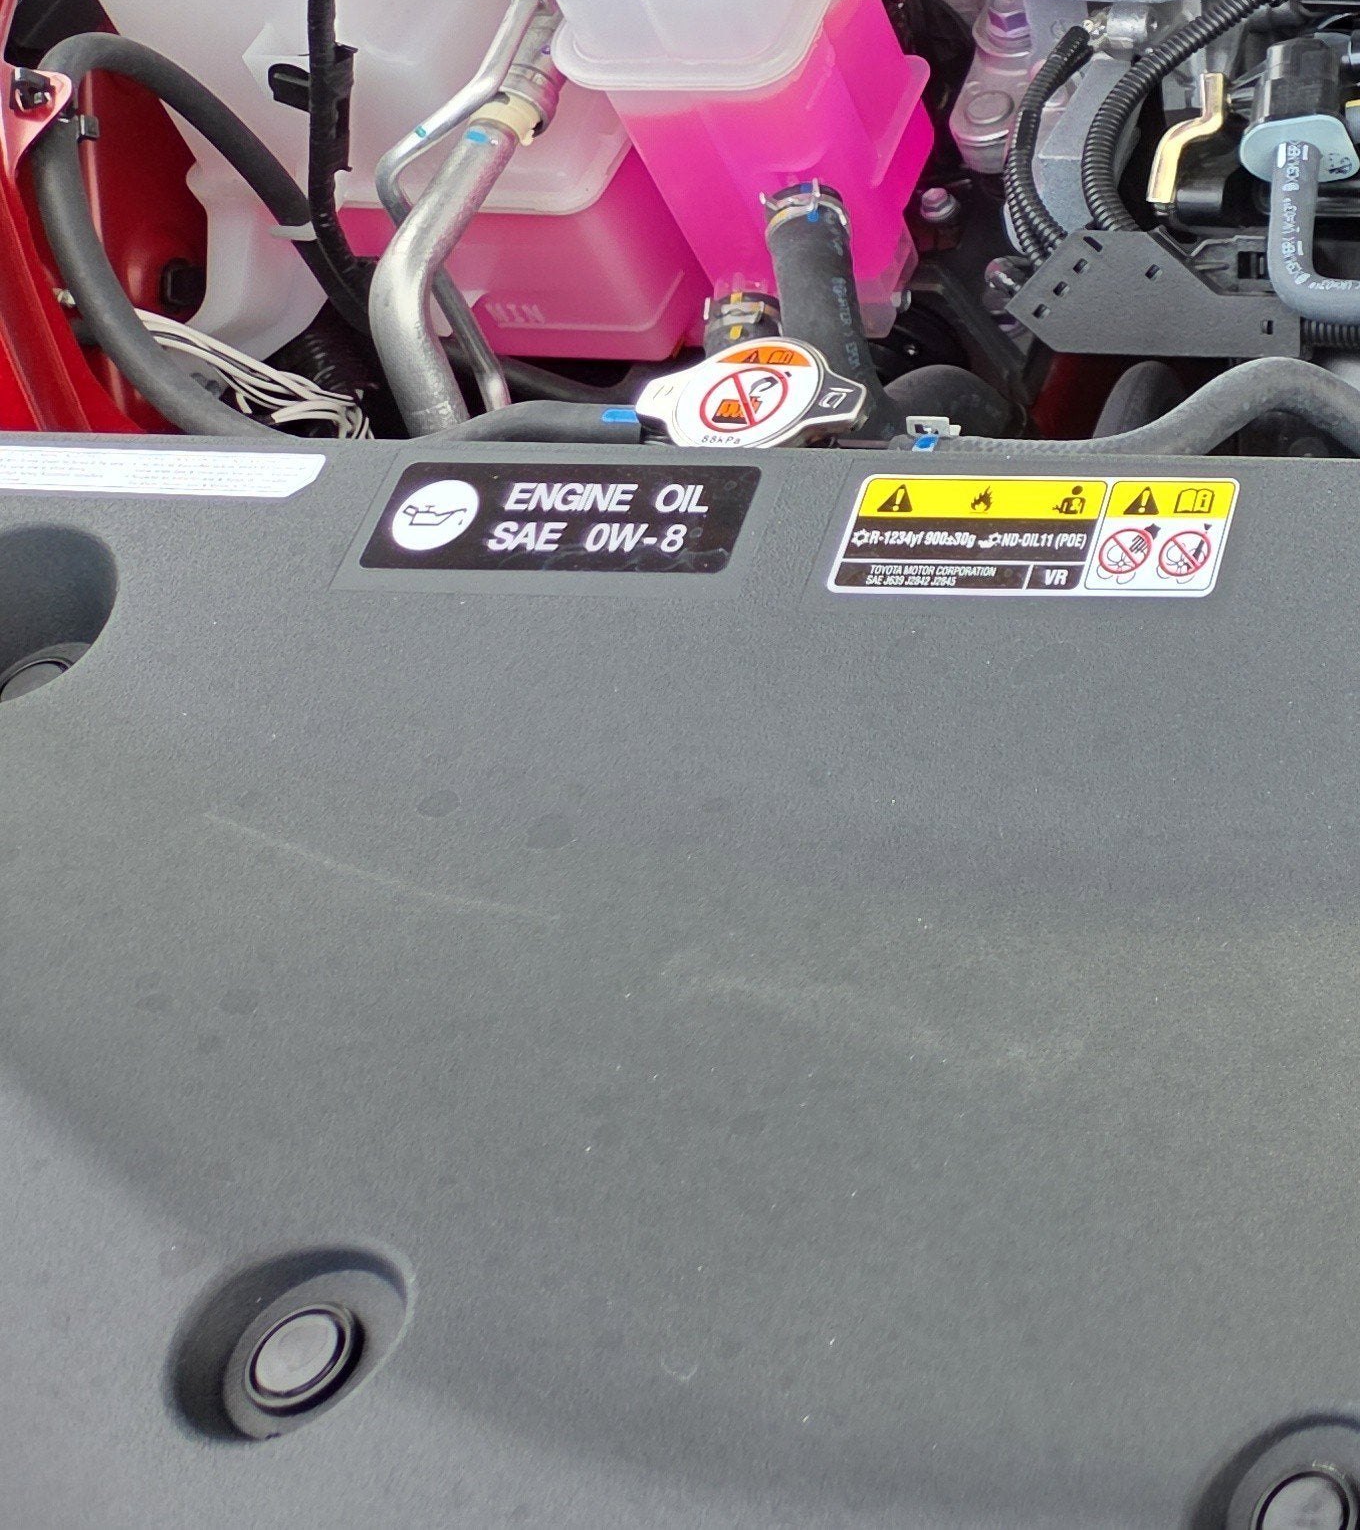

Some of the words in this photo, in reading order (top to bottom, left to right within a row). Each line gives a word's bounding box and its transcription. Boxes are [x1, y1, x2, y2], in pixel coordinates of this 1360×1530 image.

[701, 435, 742, 445] 88kPa
[504, 482, 639, 513] ENGINE
[655, 483, 709, 514] OIL
[487, 521, 568, 552] SAE
[585, 522, 688, 553] 0W-8
[868, 530, 923, 548] R-1234yf
[1002, 531, 1054, 547] ND-OIL11
[1055, 532, 1086, 550] (POE)
[870, 564, 903, 575] TOYOTA
[903, 565, 934, 576] MOTOR
[935, 566, 997, 577] CORPORATION
[1044, 569, 1069, 586] VR
[866, 575, 883, 585] SAE
[883, 575, 903, 586] J639
